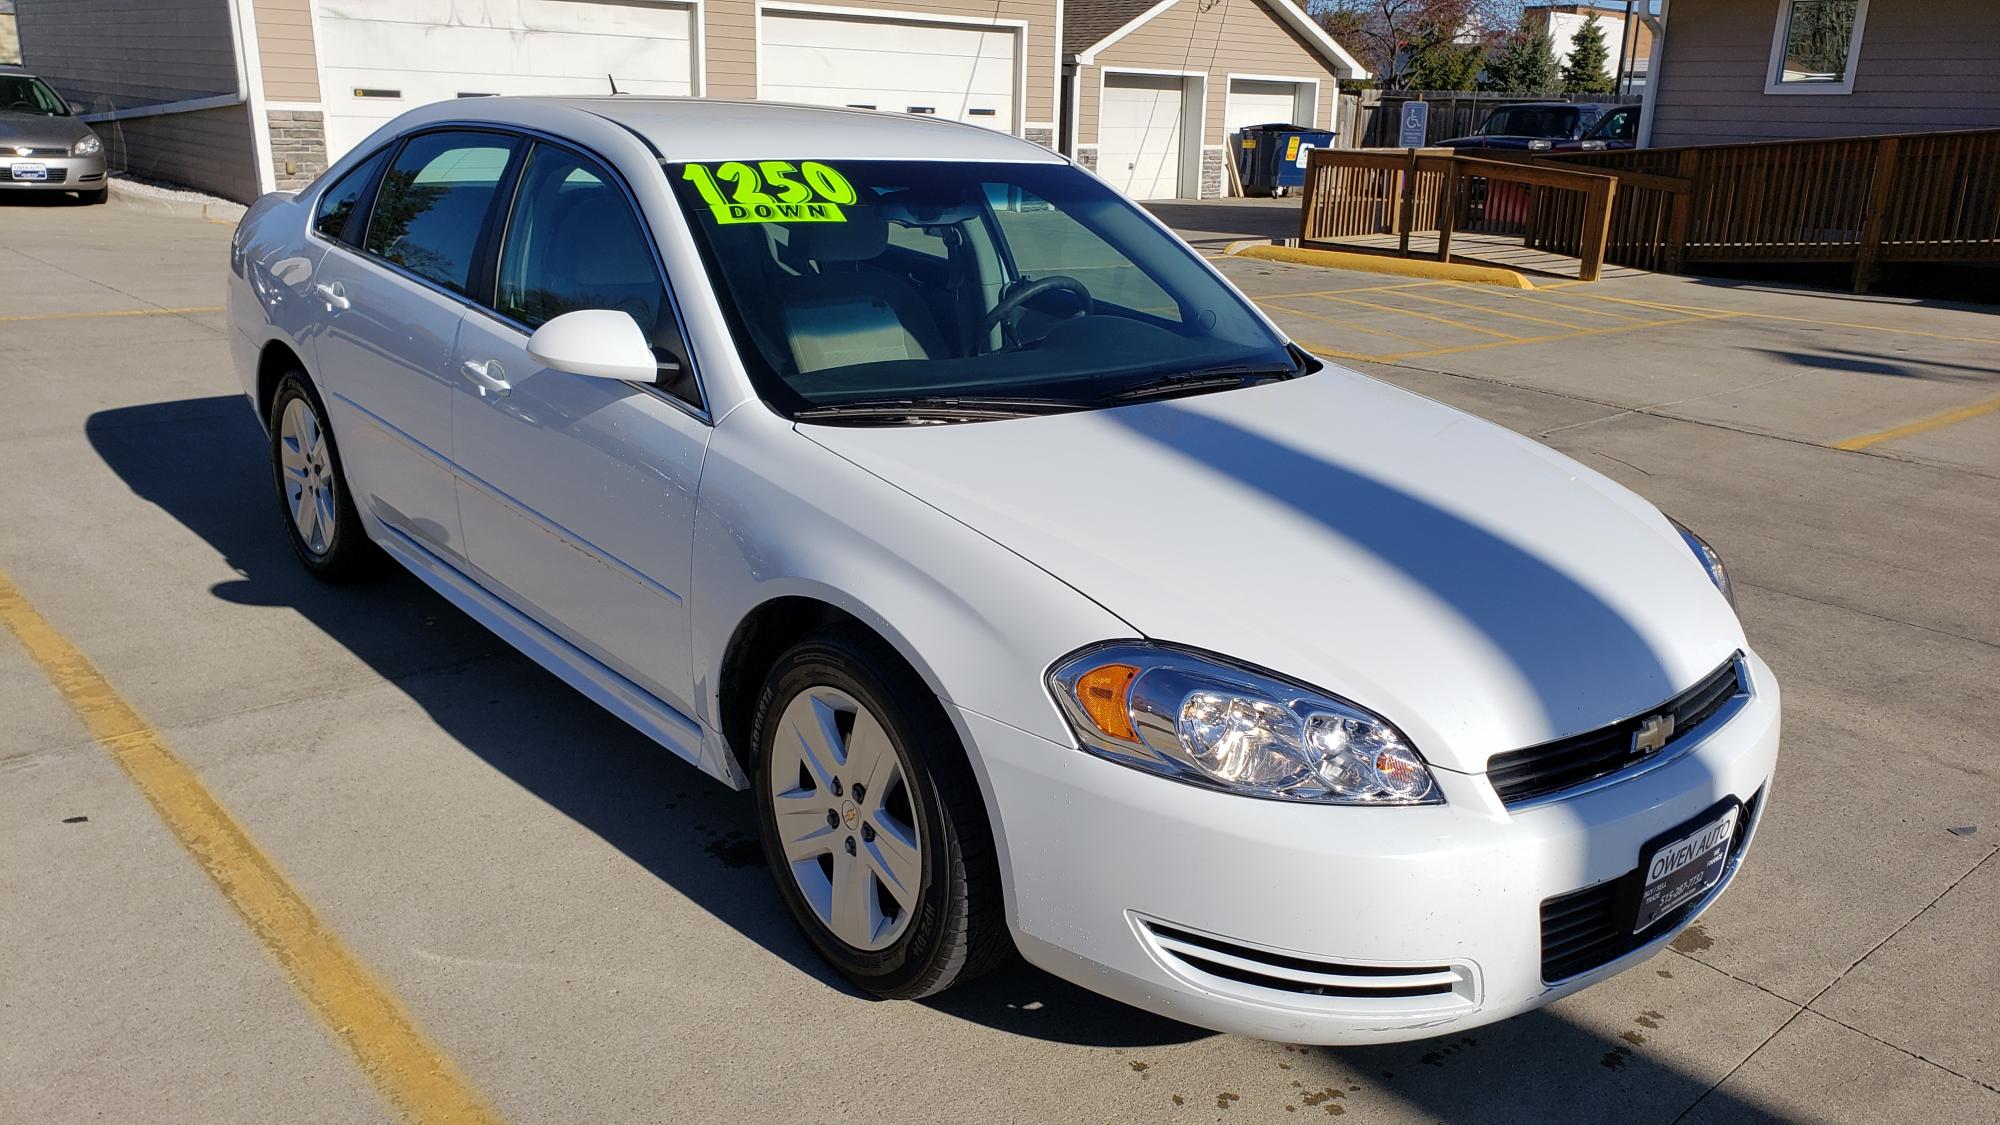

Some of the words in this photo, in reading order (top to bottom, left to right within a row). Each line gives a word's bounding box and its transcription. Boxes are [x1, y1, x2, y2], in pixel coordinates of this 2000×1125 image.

[682, 161, 857, 206] 1250
[729, 205, 827, 219] DOWN
[1651, 840, 1698, 880] OWEN
[1698, 819, 1731, 853] AUTO
